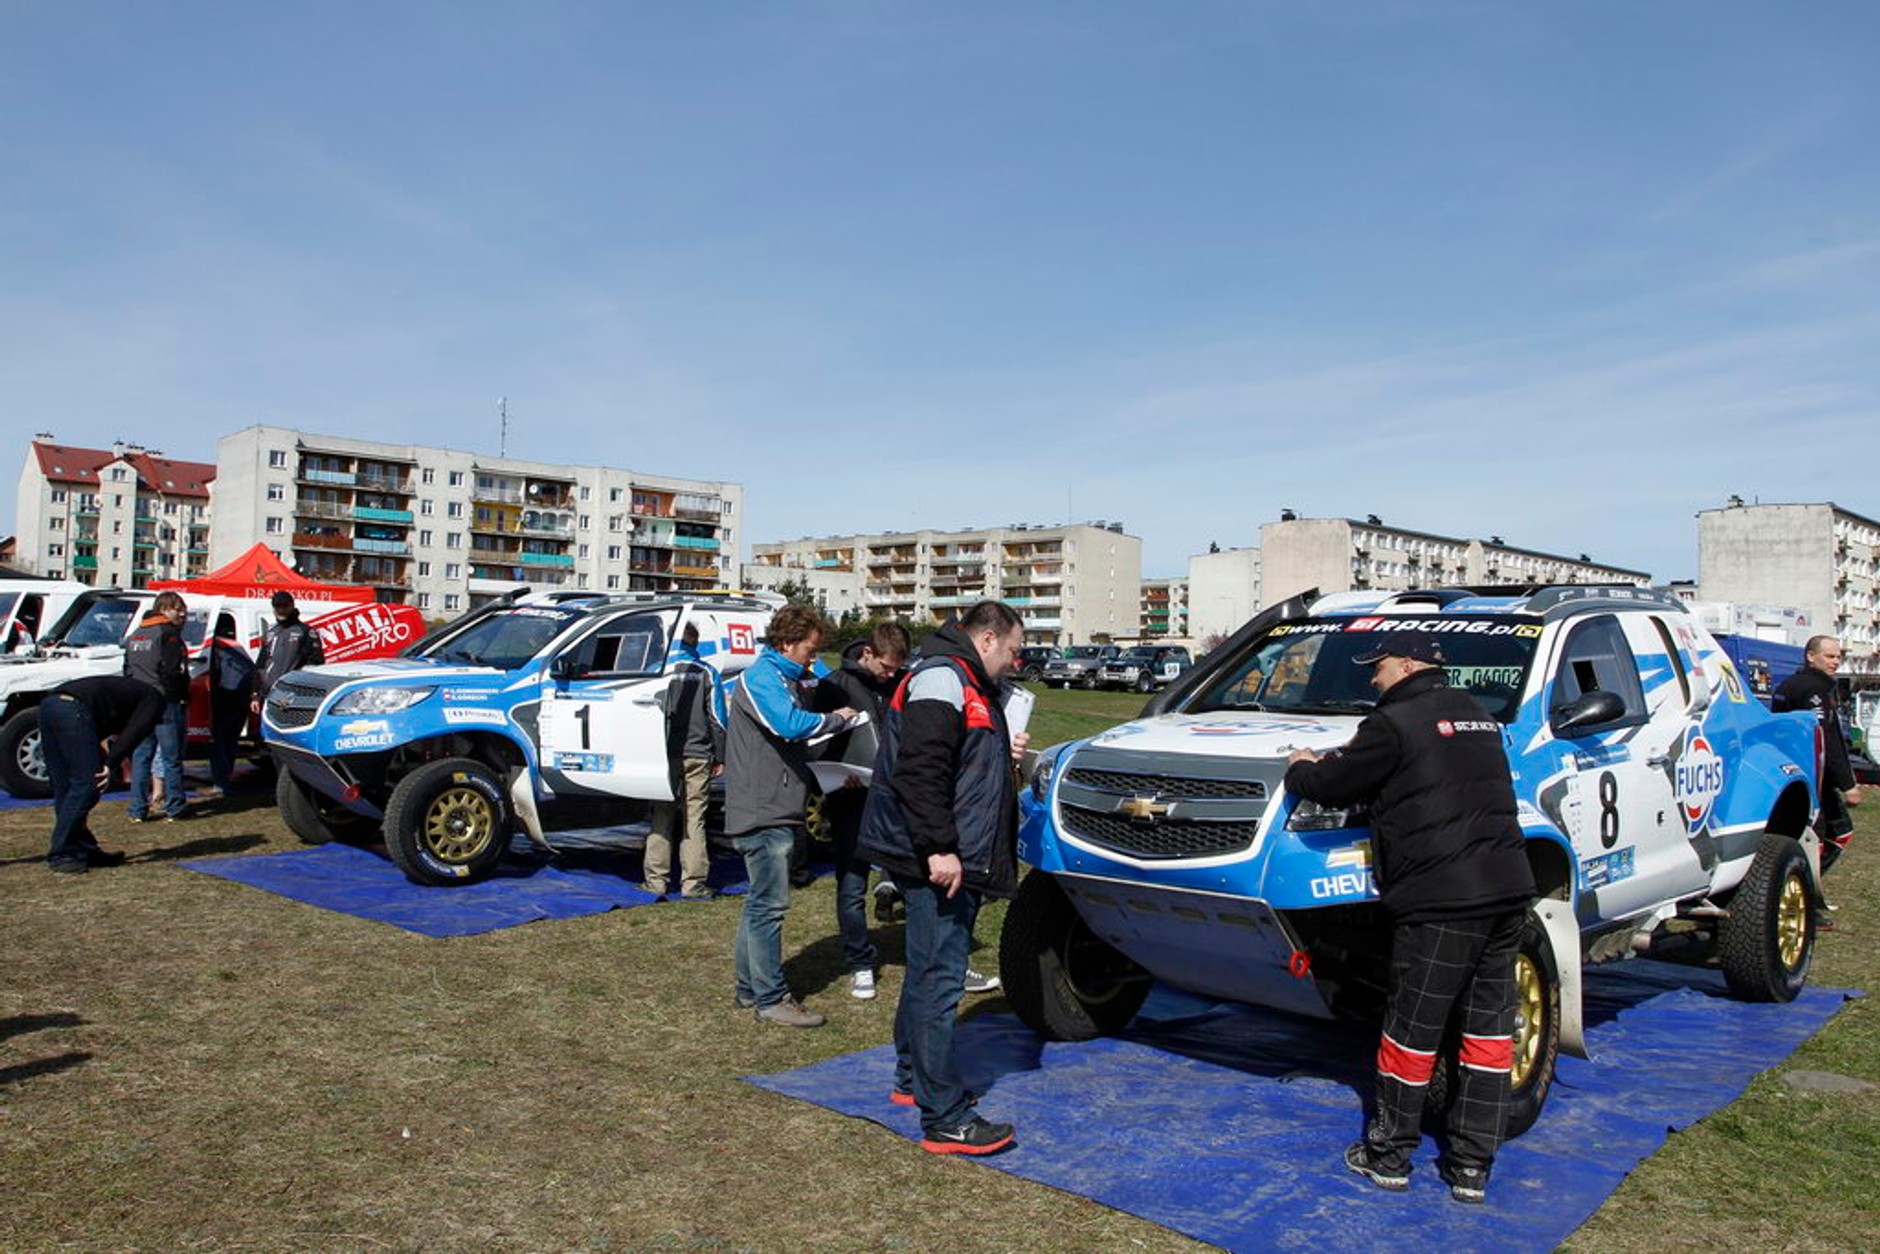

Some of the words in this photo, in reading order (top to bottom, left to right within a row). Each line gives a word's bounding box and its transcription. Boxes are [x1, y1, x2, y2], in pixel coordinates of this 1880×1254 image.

[371, 623, 410, 650] PRO
[334, 732, 395, 750] CHEVROLET
[574, 704, 590, 750] 1
[1678, 761, 1721, 797] FUCHS
[1599, 770, 1619, 849] 8
